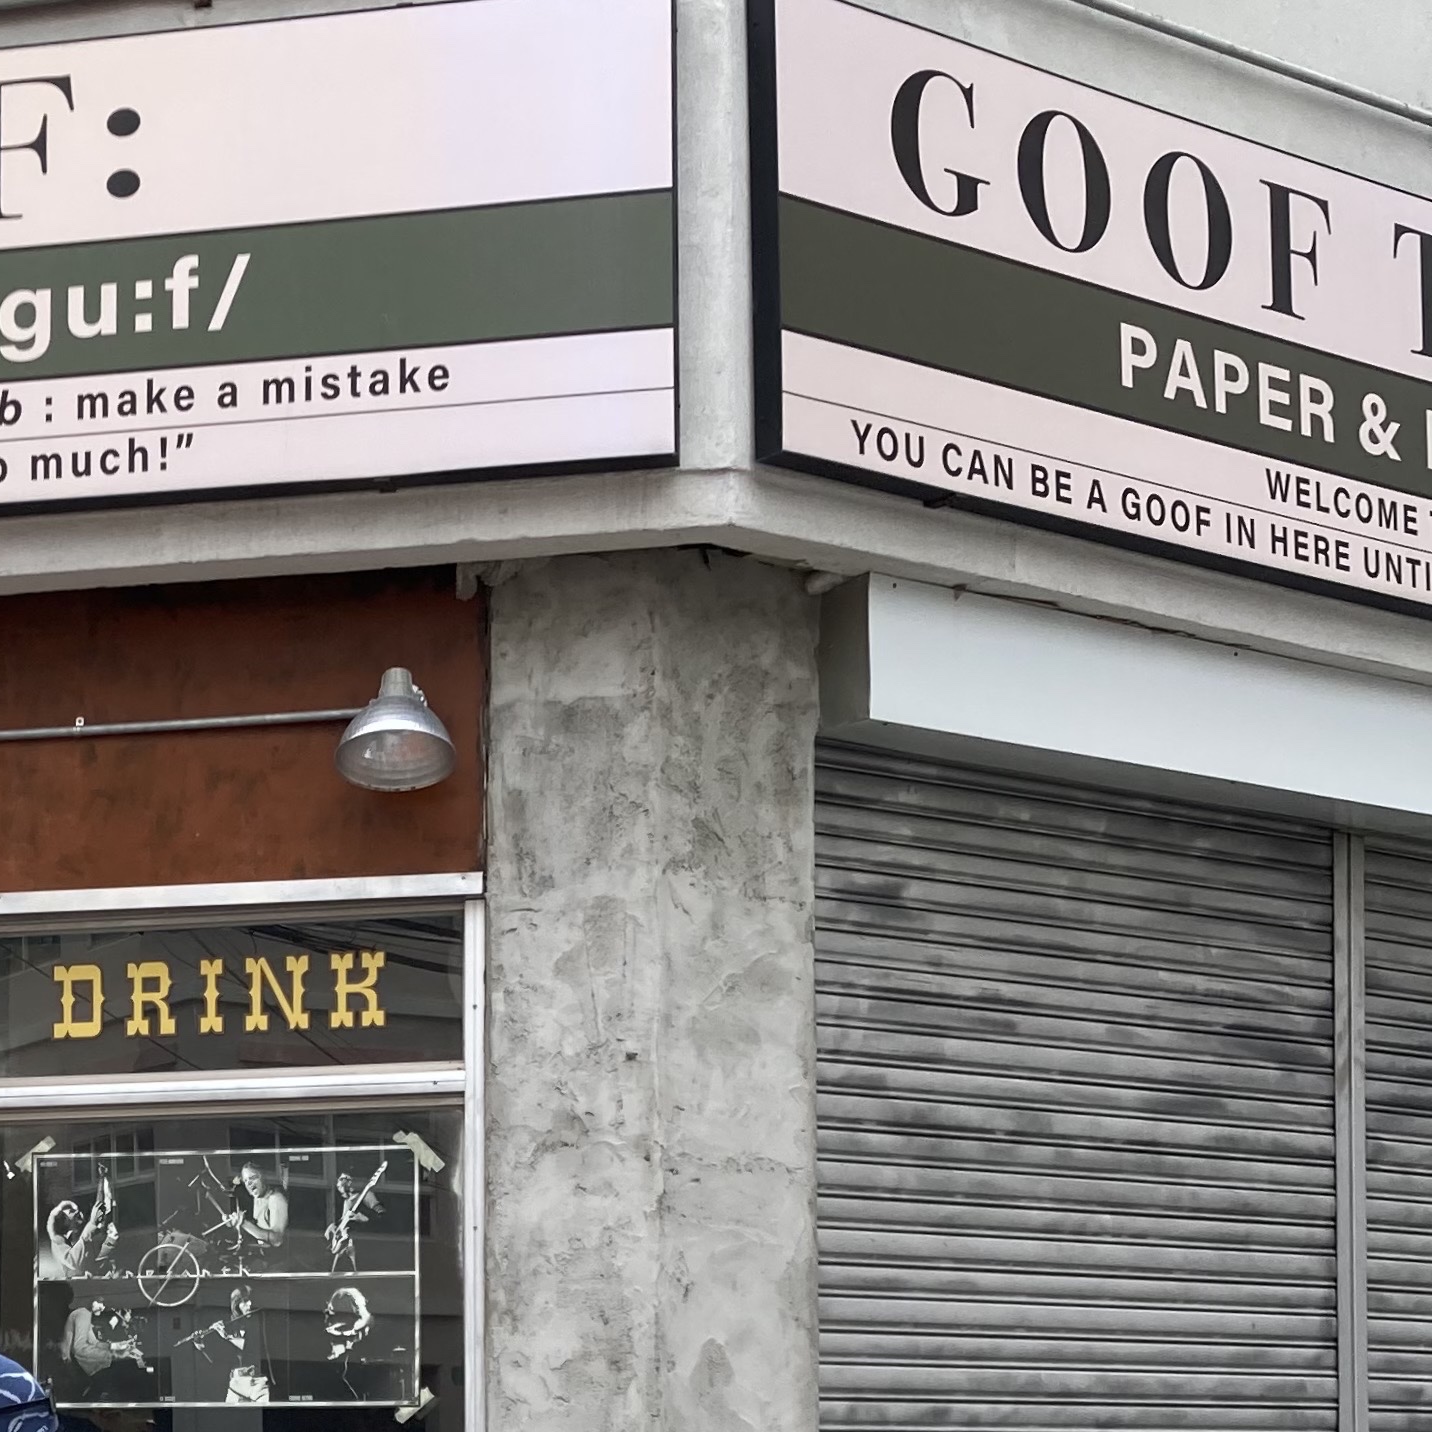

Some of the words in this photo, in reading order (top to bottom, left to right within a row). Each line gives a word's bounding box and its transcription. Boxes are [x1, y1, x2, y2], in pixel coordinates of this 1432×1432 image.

[891, 66, 1331, 320] GOOF
[78, 379, 194, 420] make
[218, 382, 237, 408] a
[263, 358, 449, 404] mistake
[1121, 323, 1334, 442] PAPER
[1359, 394, 1401, 461] &
[851, 420, 924, 468] YOU
[942, 443, 1013, 490] CAN
[1031, 464, 1072, 504] BE
[1087, 479, 1107, 513] A
[1122, 488, 1210, 536] GOOF
[1226, 513, 1255, 549] IN
[1271, 524, 1350, 572] HERE
[1266, 468, 1418, 536] WELCOME
[53, 951, 386, 1039] DRINK
